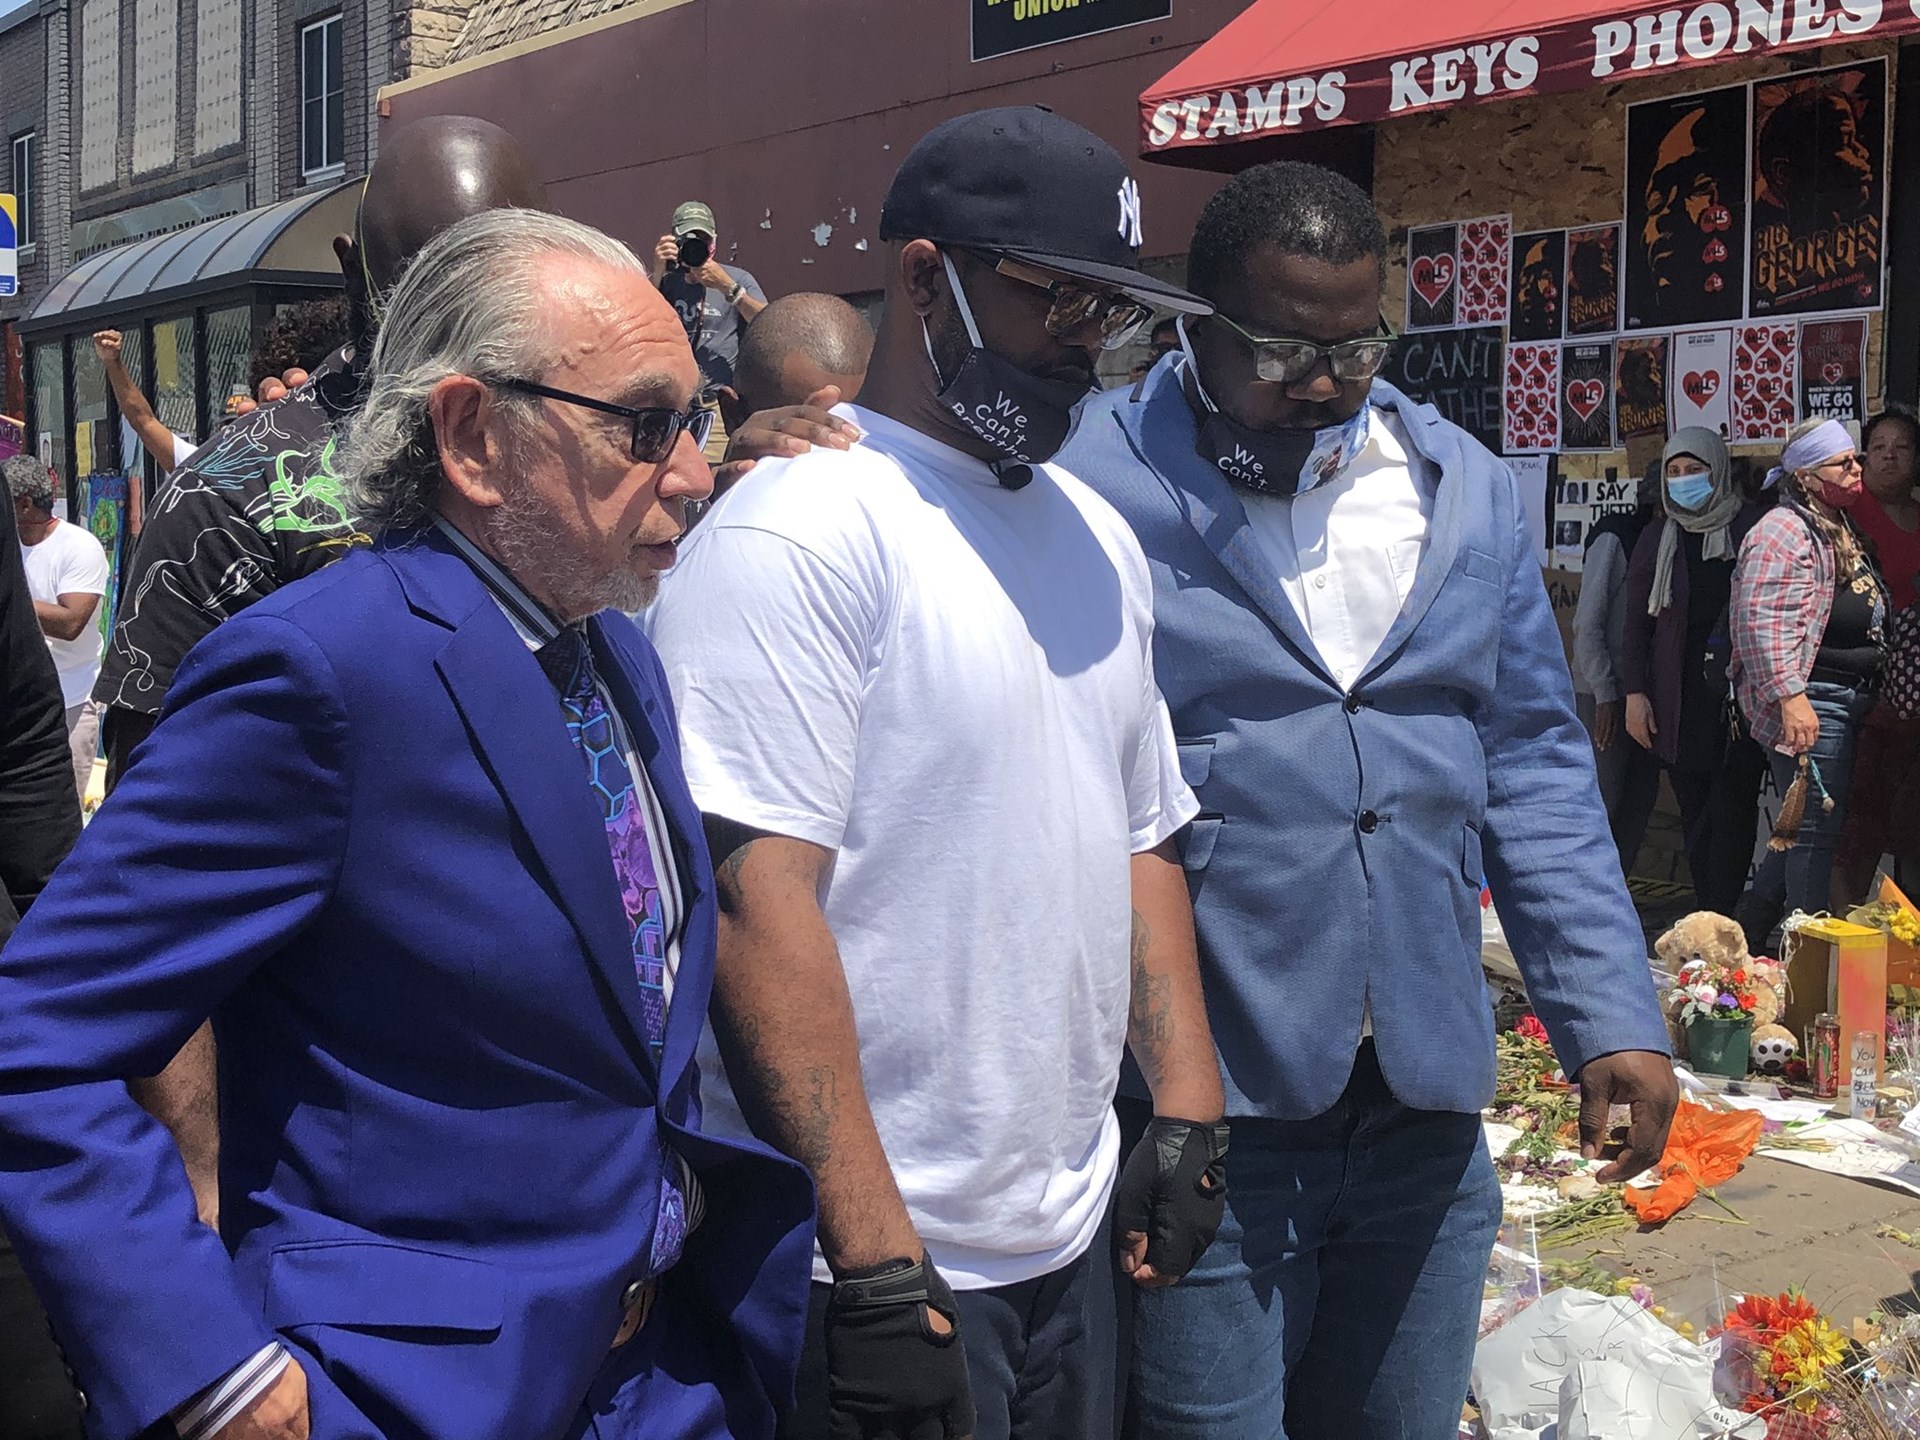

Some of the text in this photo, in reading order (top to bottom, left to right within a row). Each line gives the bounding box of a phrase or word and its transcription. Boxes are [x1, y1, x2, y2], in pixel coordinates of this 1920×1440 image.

[1149, 0, 1884, 147] STAMPS KEYS PHONES
[995, 390, 1028, 428] We
[1808, 392, 1853, 408] WE GO
[952, 401, 1030, 462] Breathe
[975, 404, 1027, 446] Can't
[1218, 456, 1268, 490] Can't
[1234, 443, 1264, 475] We
[1596, 482, 1630, 501] SAY
